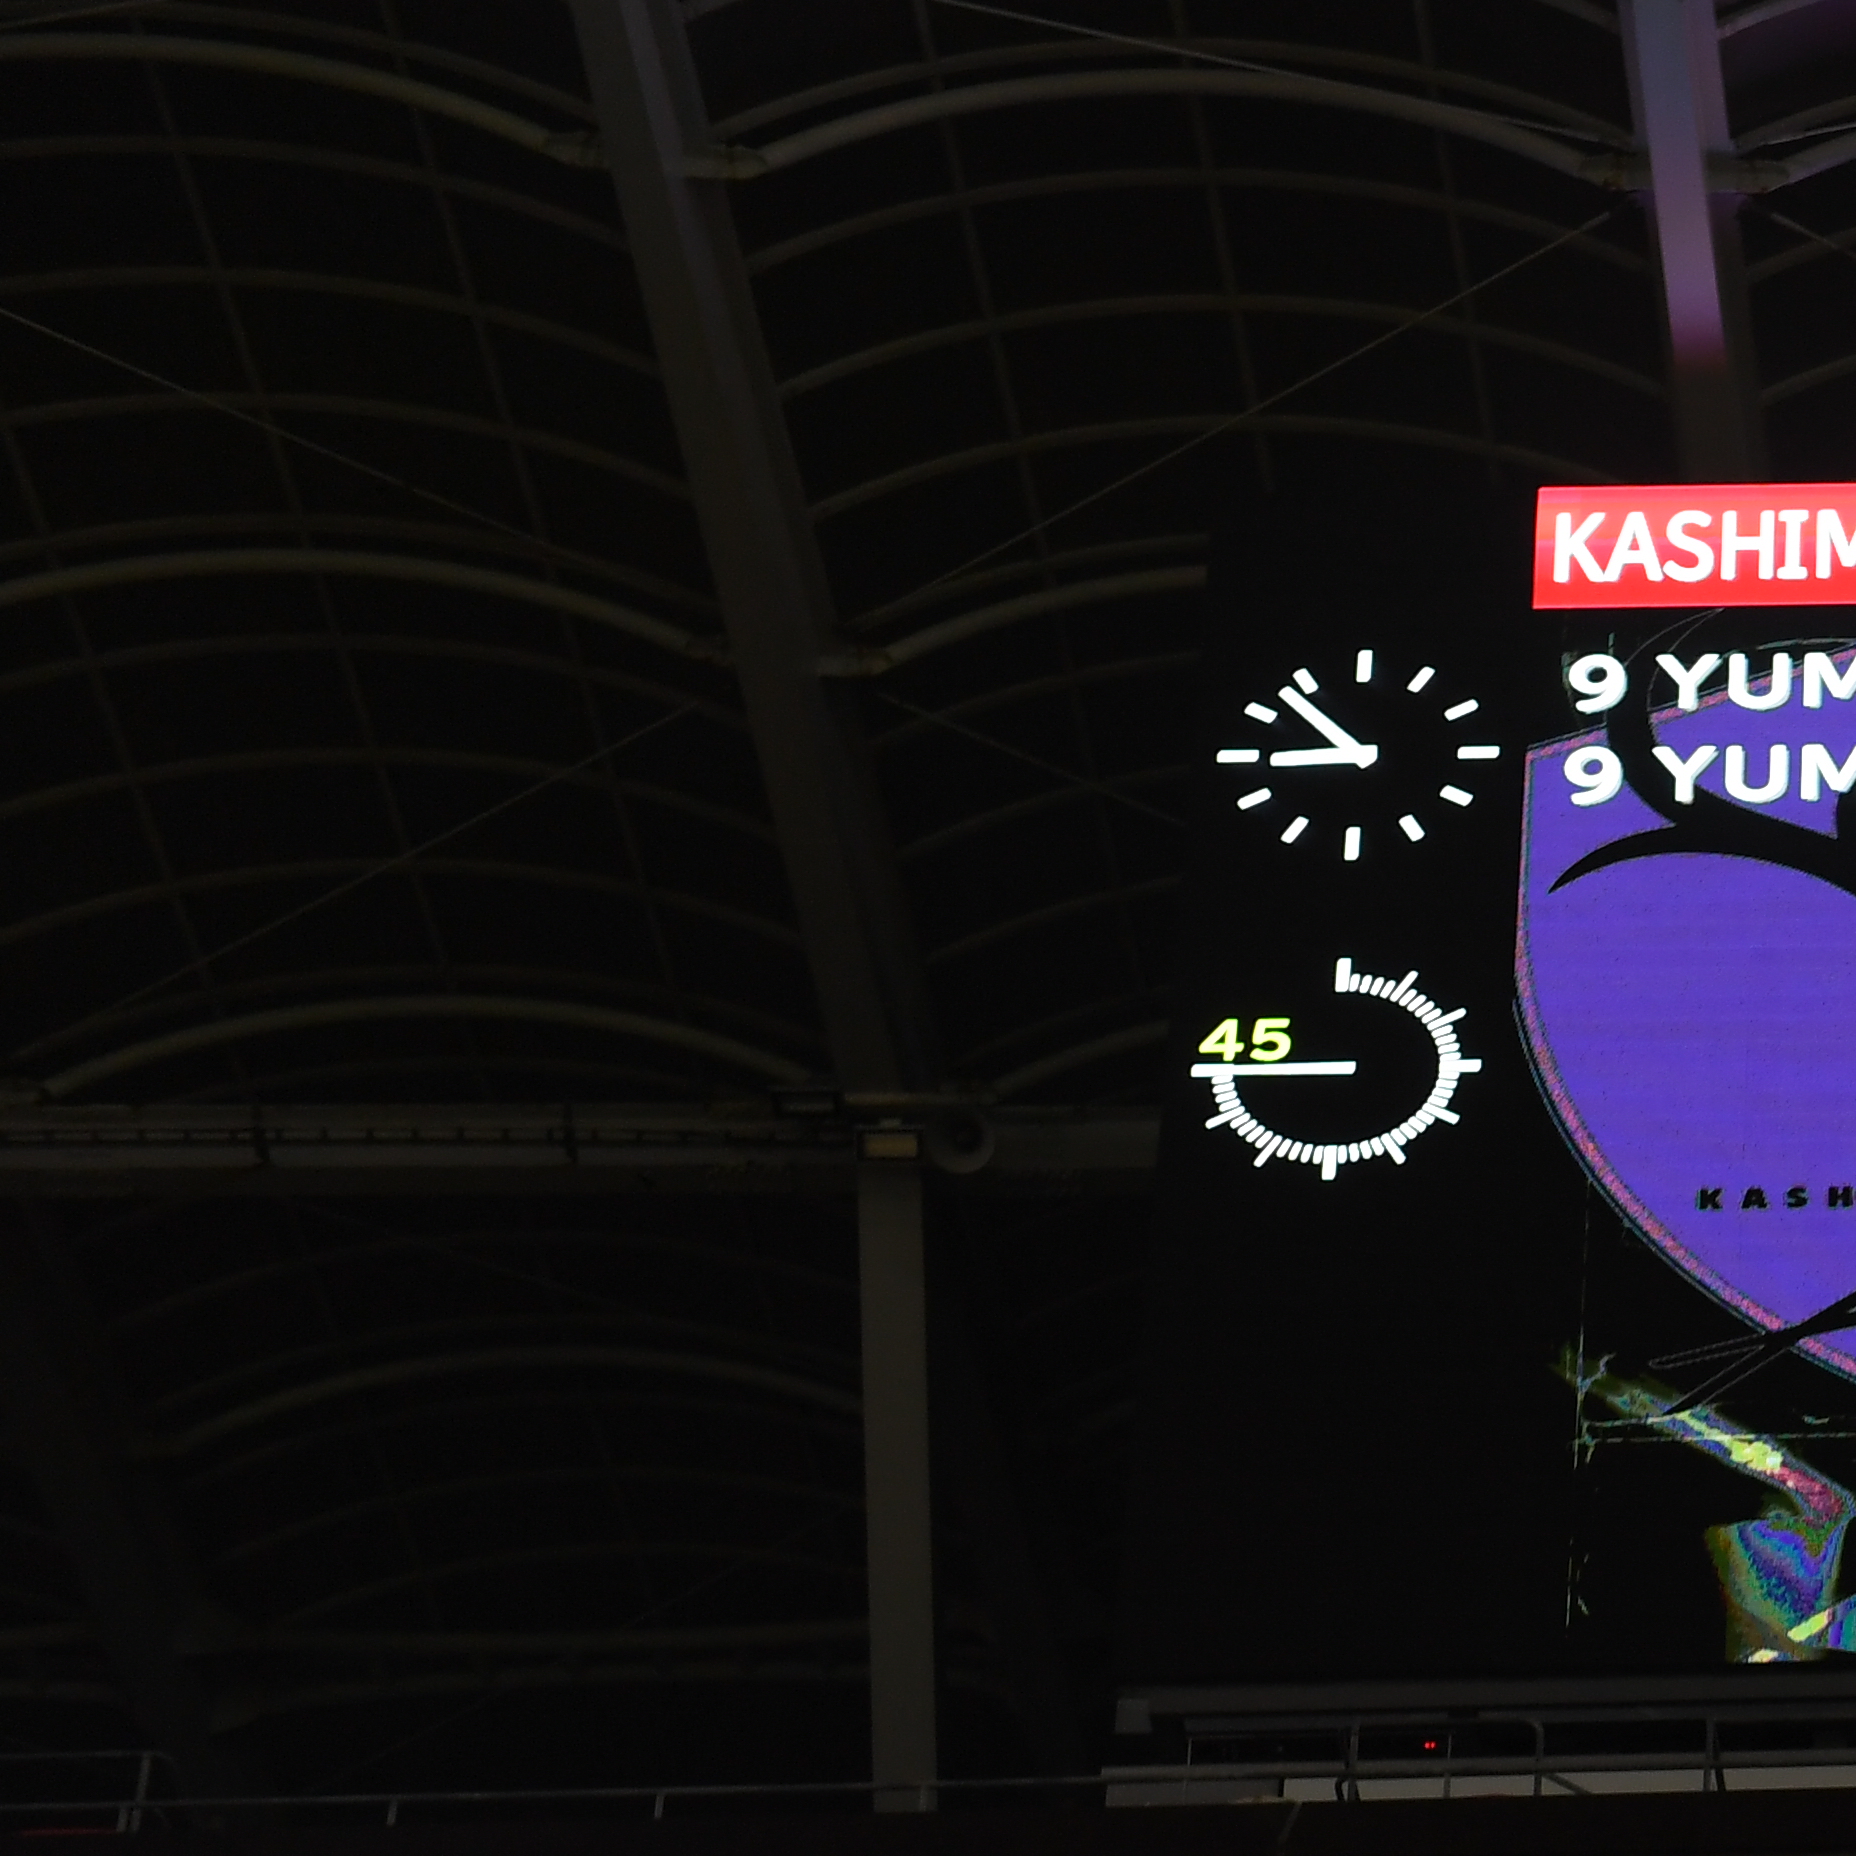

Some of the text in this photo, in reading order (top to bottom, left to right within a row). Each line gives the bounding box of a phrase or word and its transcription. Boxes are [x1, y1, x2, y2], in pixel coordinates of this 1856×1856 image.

[1568, 656, 1625, 711] 9
[1565, 748, 1621, 806] 9
[1201, 1016, 1293, 1062] 45
